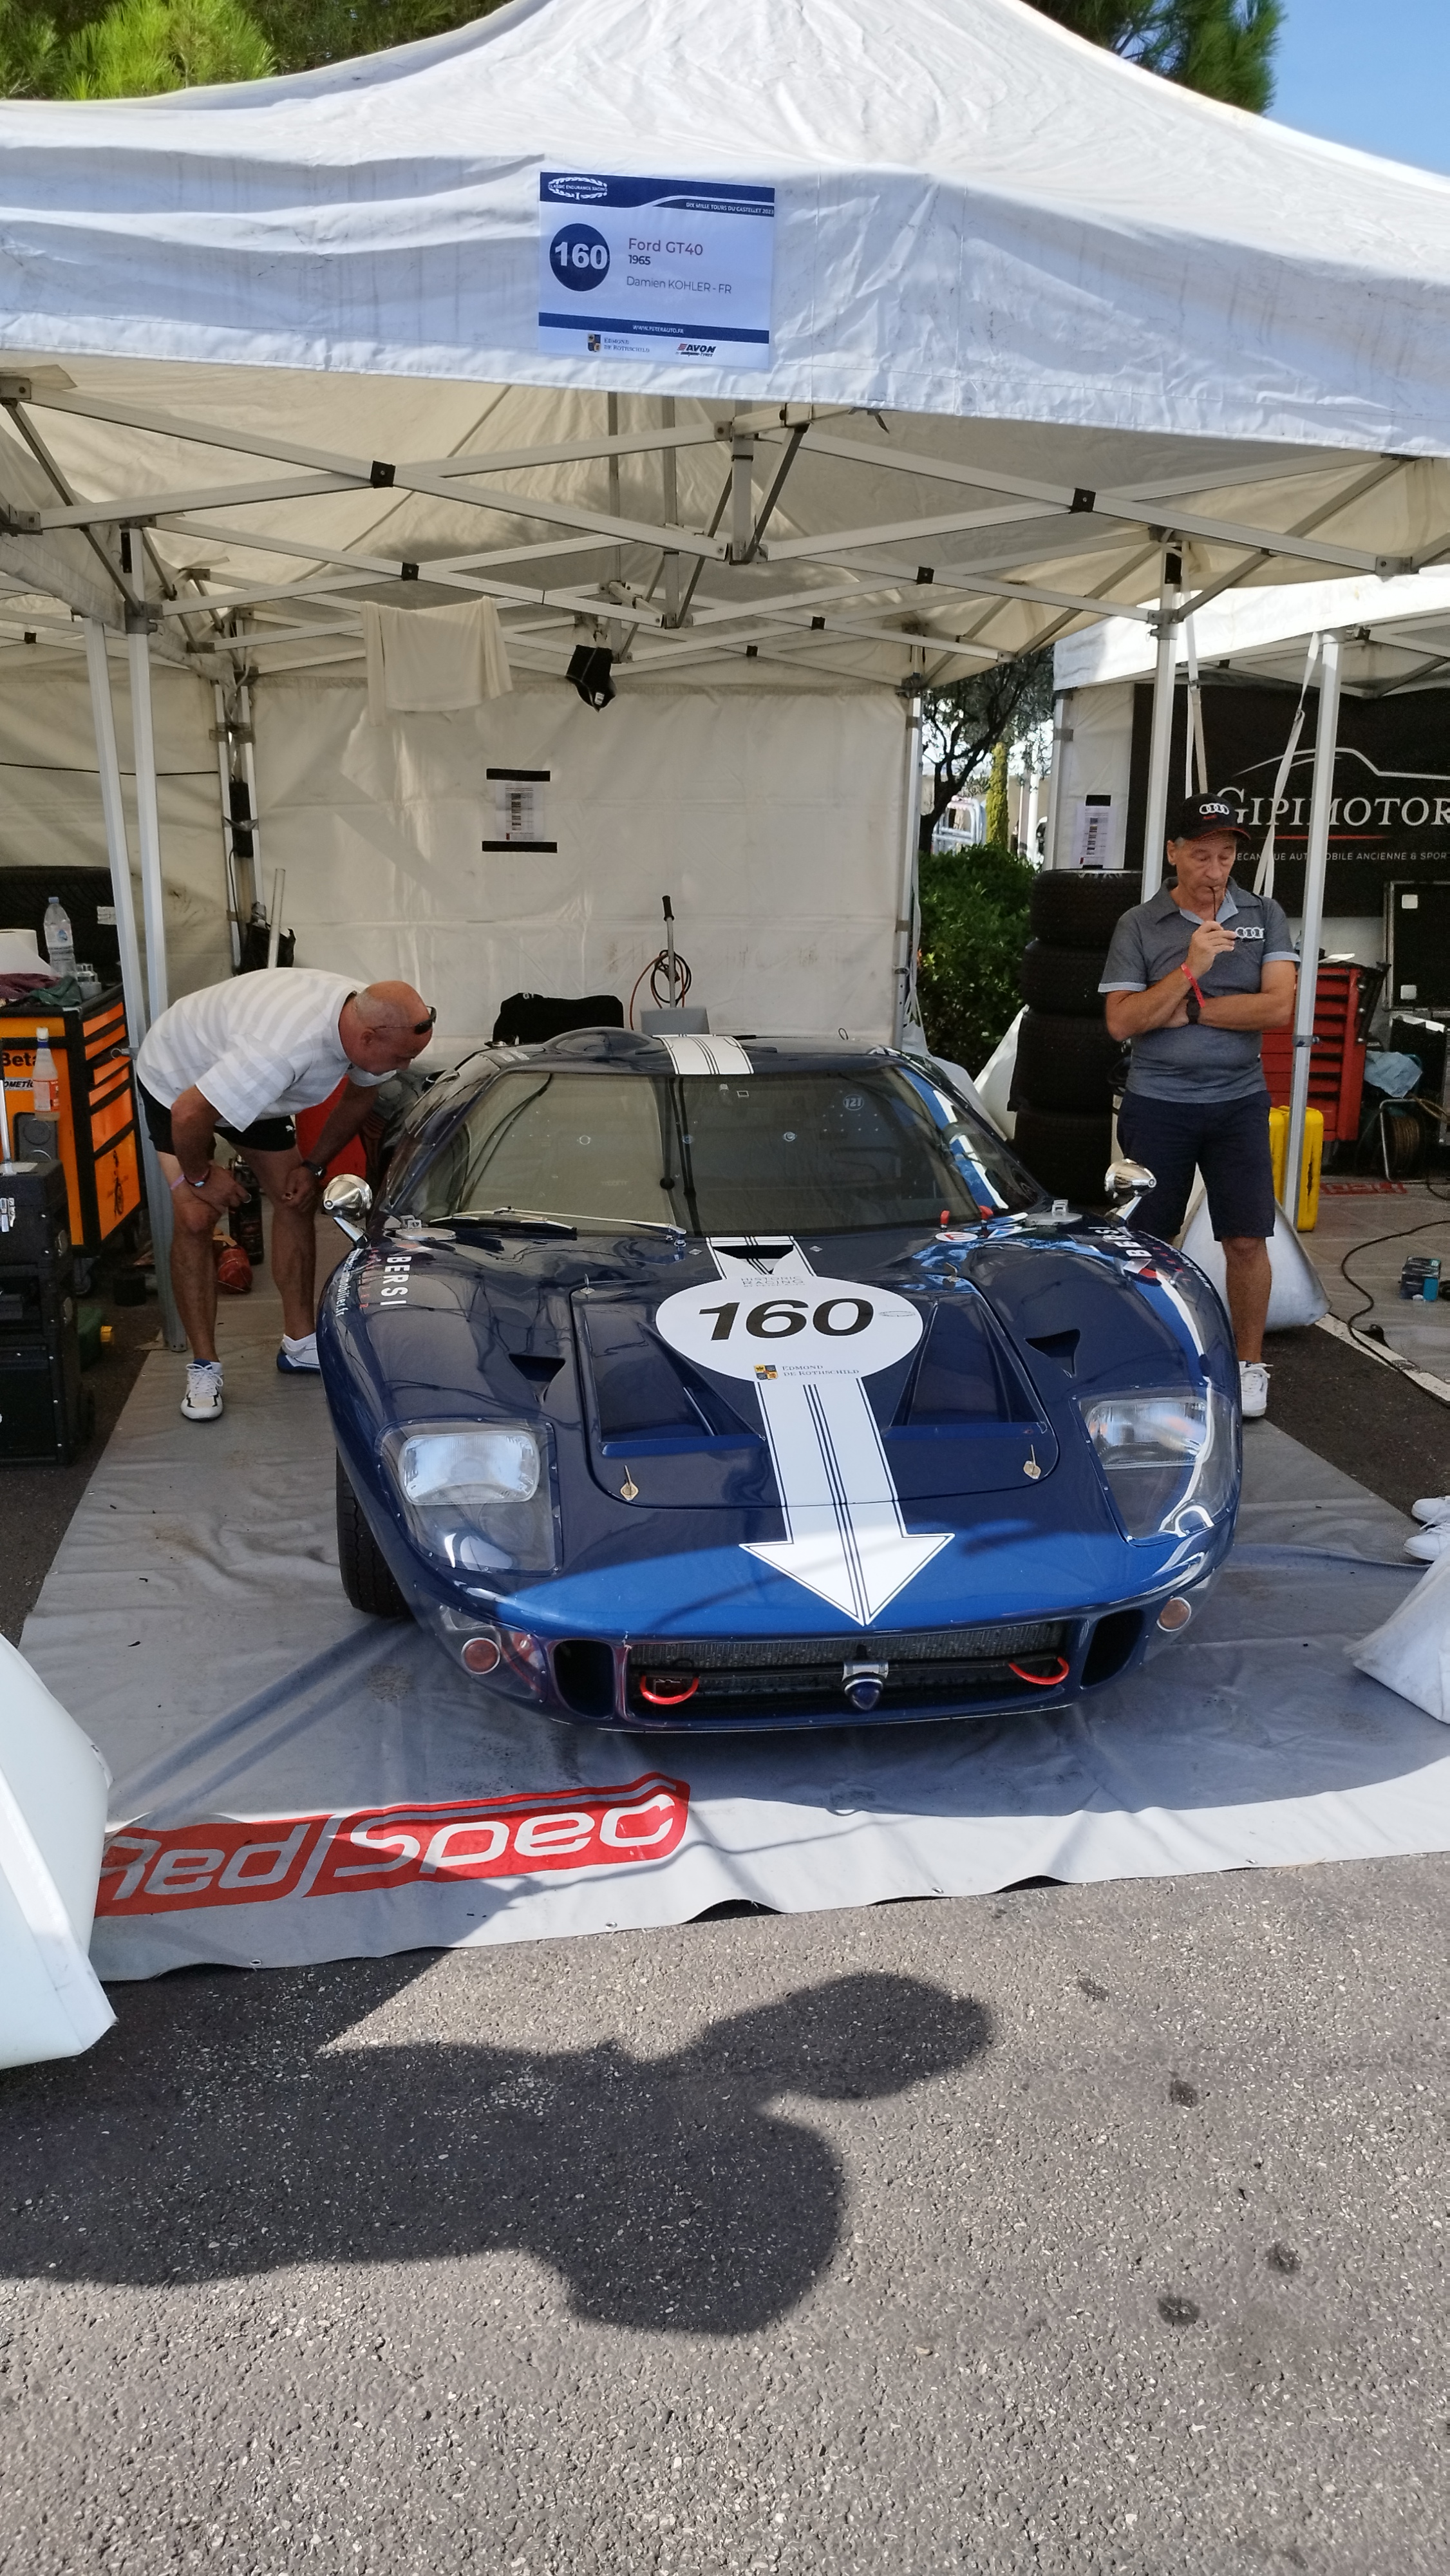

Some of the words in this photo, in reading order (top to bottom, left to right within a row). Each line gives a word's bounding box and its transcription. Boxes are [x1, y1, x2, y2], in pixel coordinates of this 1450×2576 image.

[554, 242, 608, 270] 160
[628, 238, 661, 252] Ford
[665, 241, 703, 256] GT40
[628, 254, 652, 265] 1965
[626, 276, 666, 289] Damien
[668, 279, 711, 292] KOHLER
[719, 283, 732, 294] FR
[686, 344, 717, 353] AVON
[1289, 852, 1353, 861] AUTOBILE
[1355, 852, 1407, 860] ANCIENNE
[1420, 852, 1450, 860] SPOR
[1088, 1226, 1153, 1257] BERSI
[380, 1255, 412, 1306] BERSI
[699, 1298, 874, 1341] 160
